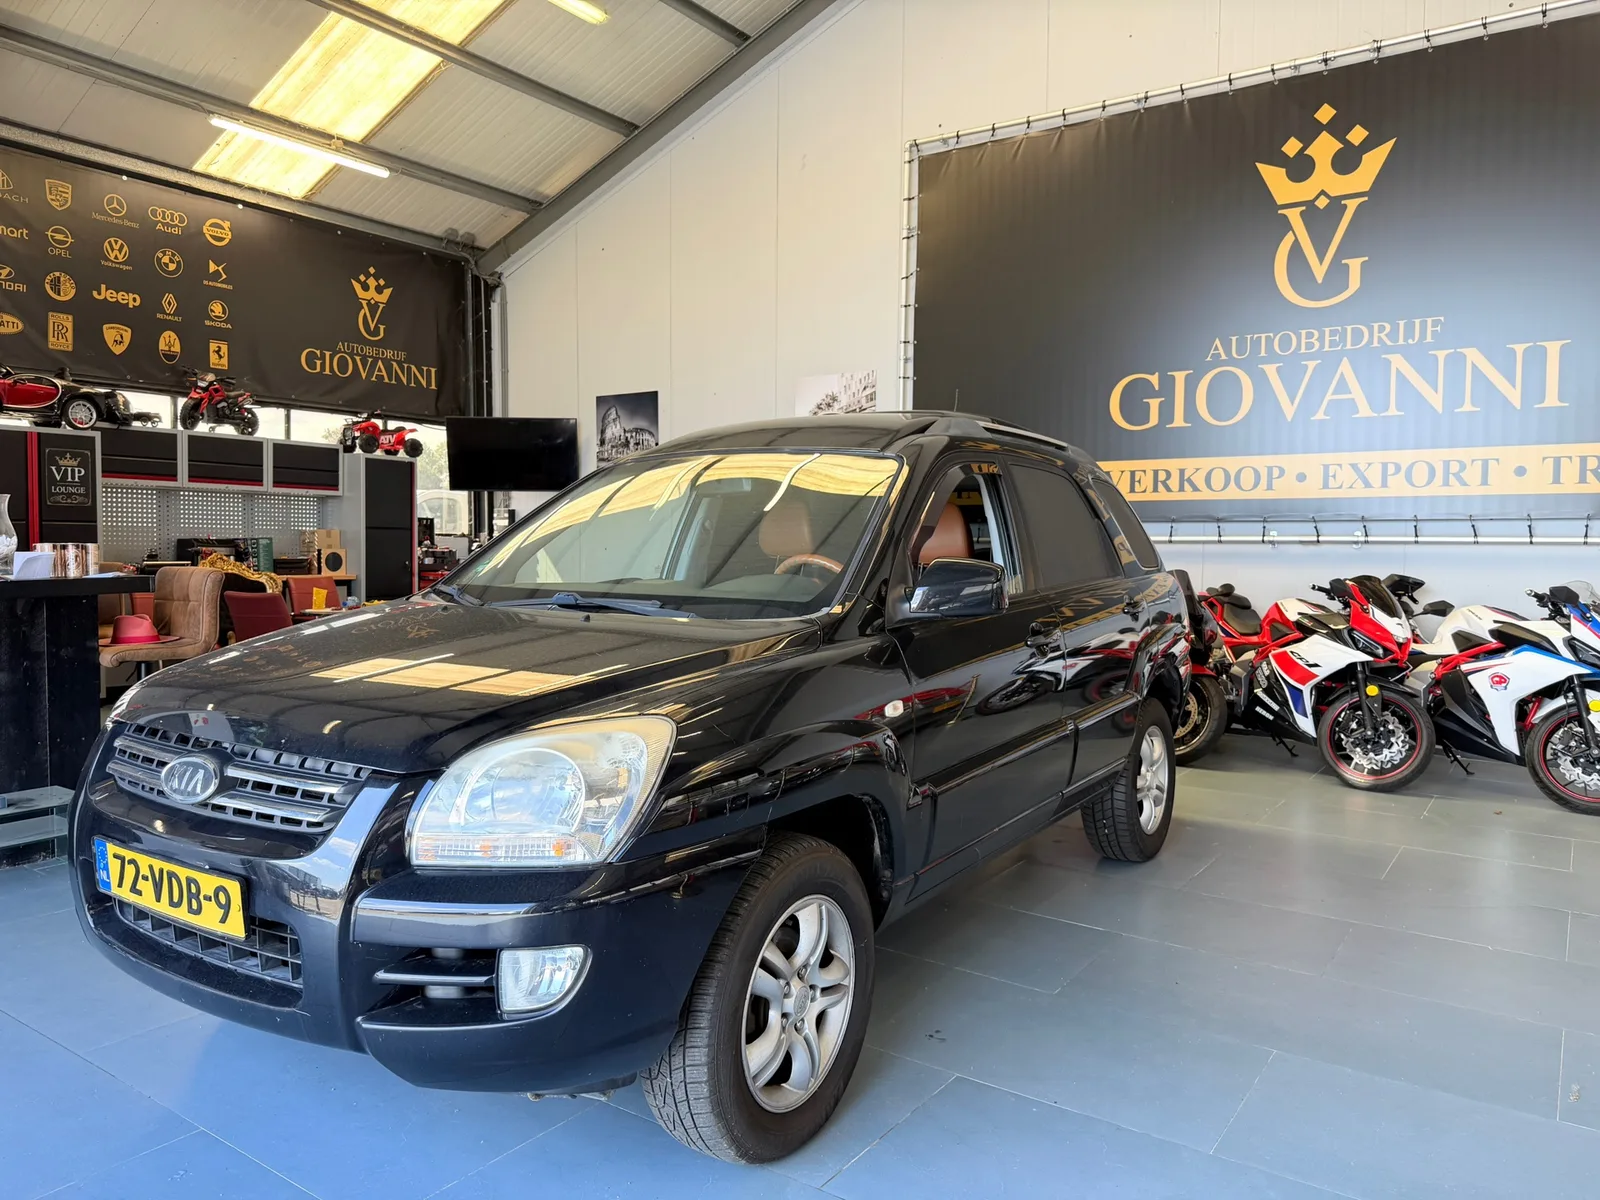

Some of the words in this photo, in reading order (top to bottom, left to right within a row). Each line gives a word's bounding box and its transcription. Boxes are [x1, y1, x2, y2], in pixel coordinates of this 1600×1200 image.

[91, 211, 140, 229] Mercedes-Benz
[155, 223, 182, 235] Audi
[205, 226, 230, 238] VOLVO
[47, 247, 73, 259] OPEL
[156, 250, 181, 262] BMW
[100, 259, 133, 271] Volkswagen
[92, 283, 141, 308] Jeep
[156, 313, 182, 322] RENAULT
[1205, 316, 1445, 362] AUTOBEDRIJF
[336, 341, 407, 361] AUTOBEDRIJF
[300, 348, 437, 390] GIOVANNI
[1108, 339, 1572, 431] GIOVANNI
[50, 465, 86, 482] VIP
[1104, 464, 1286, 495] VERKOOP
[1318, 457, 1500, 490] EXPORT
[51, 485, 86, 494] LOUNGE
[168, 763, 204, 795] KIA
[112, 853, 232, 925] 72-VDB-9
